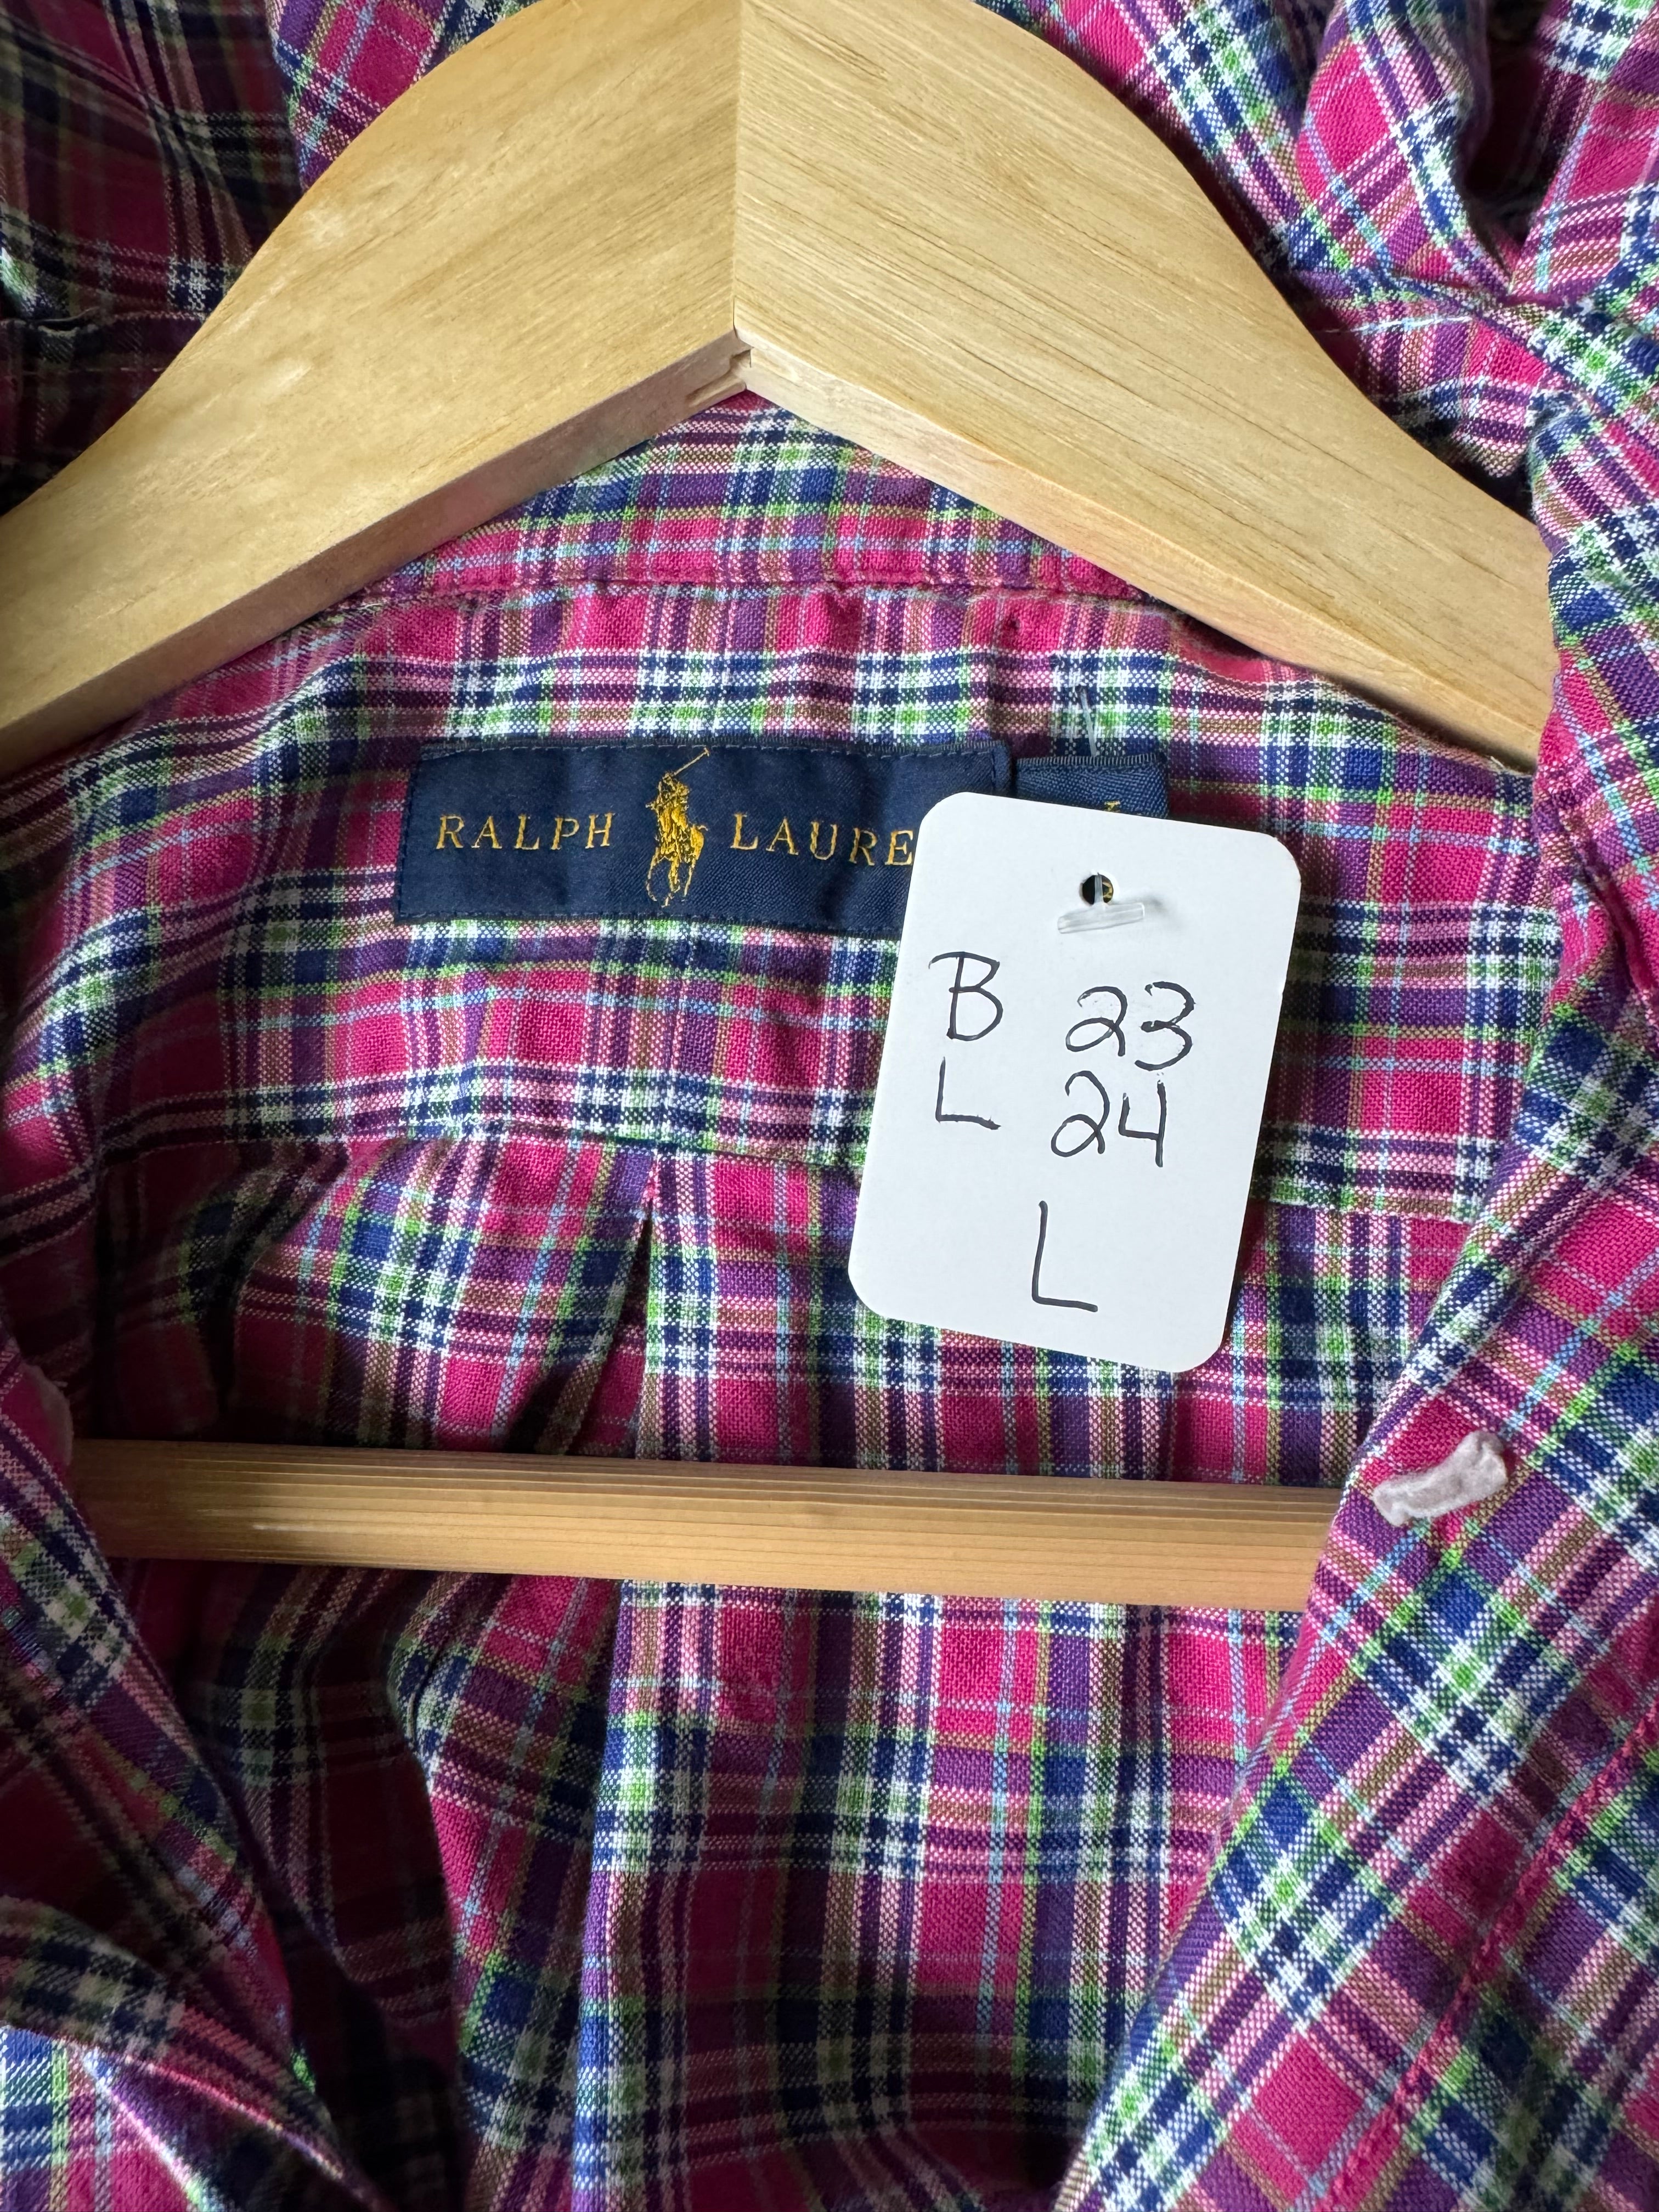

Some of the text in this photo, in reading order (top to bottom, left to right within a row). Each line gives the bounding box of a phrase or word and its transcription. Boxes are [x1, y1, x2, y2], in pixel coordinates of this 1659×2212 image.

[436, 812, 915, 866] RALPH LAURE
[928, 951, 1196, 1071] B 23
[934, 1056, 1167, 1167] L 24
[1031, 1200, 1099, 1313] L
